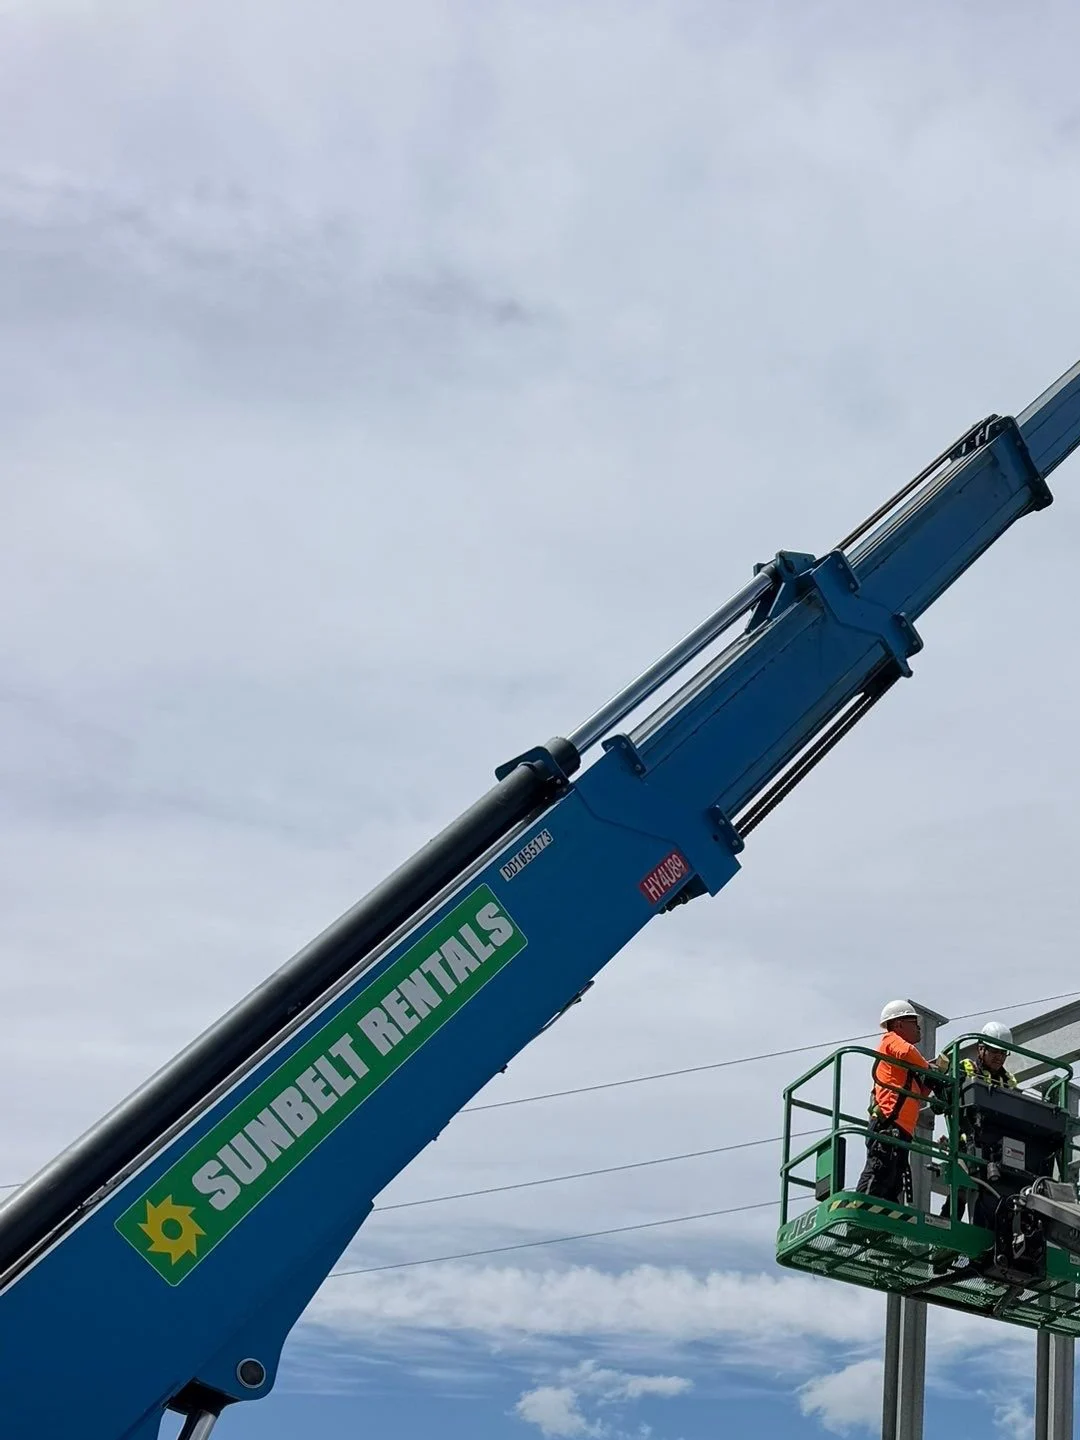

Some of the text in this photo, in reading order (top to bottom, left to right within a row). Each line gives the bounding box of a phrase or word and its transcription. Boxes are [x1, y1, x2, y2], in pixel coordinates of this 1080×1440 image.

[644, 854, 684, 901] HY4U89
[192, 902, 514, 1211] SUNBELT RENTALS
[788, 1207, 819, 1243] JLG
